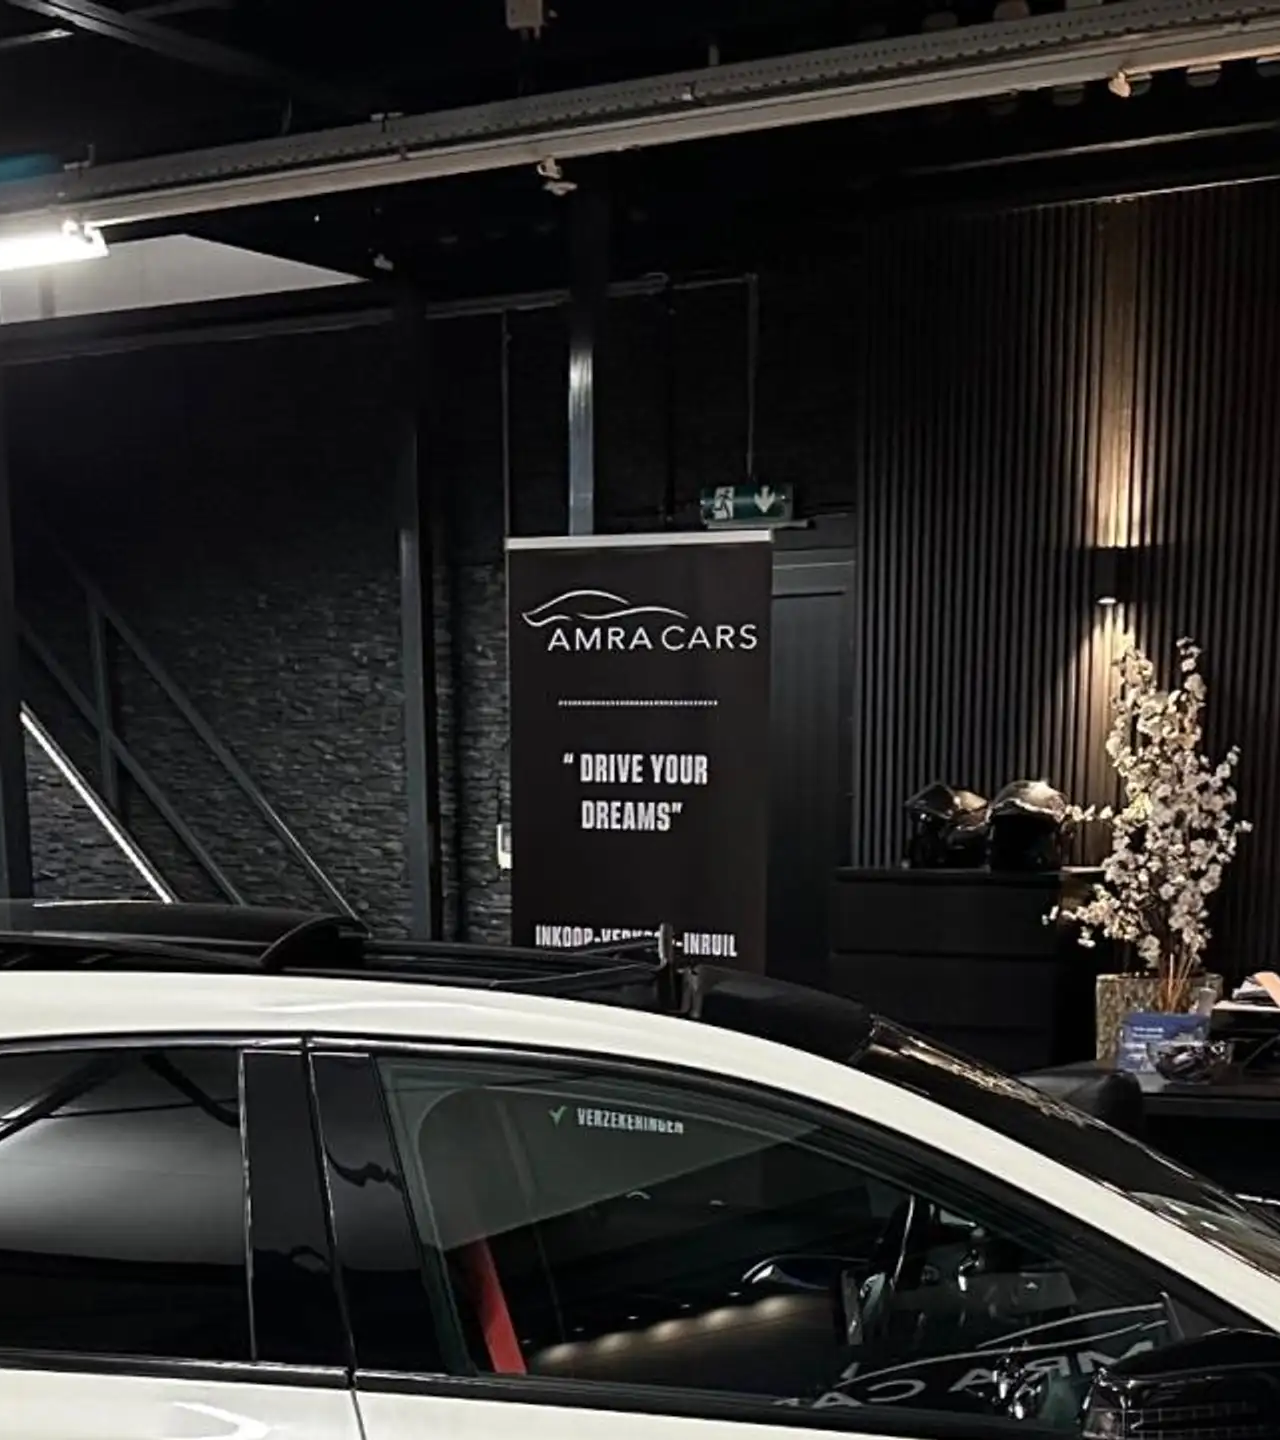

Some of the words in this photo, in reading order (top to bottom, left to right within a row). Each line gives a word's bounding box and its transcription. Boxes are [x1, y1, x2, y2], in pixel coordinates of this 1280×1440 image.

[548, 626, 653, 652] AMRA
[661, 623, 758, 651] CARS
[580, 753, 644, 784] DRIVE
[650, 753, 708, 785] YOUR
